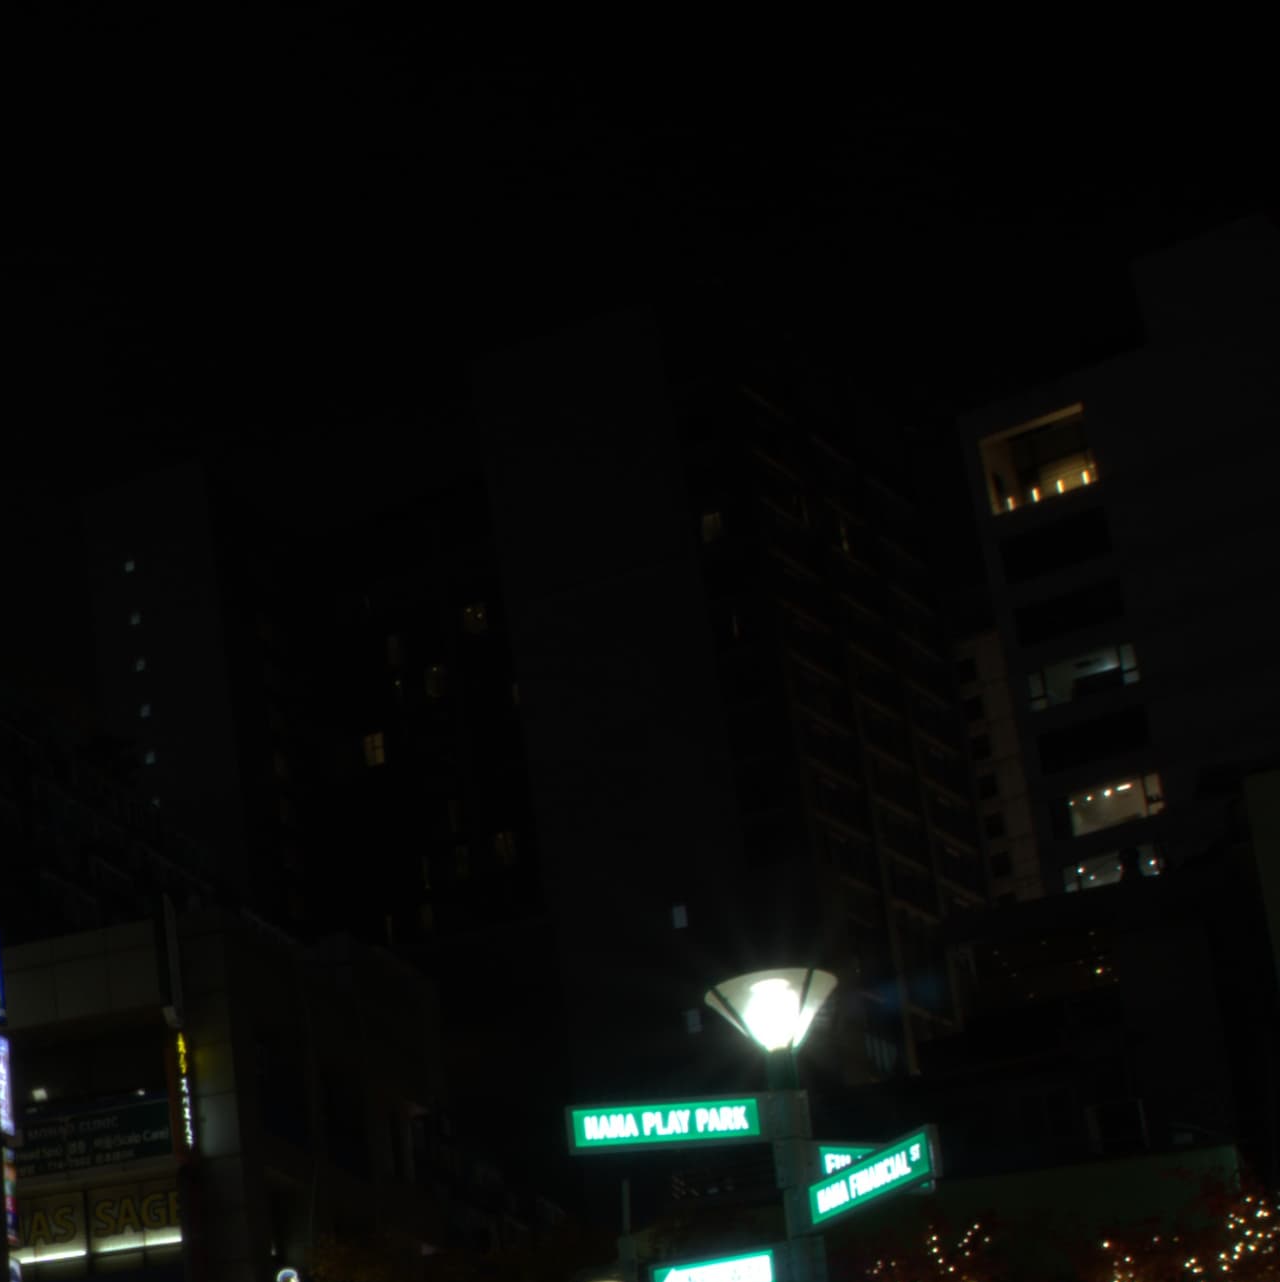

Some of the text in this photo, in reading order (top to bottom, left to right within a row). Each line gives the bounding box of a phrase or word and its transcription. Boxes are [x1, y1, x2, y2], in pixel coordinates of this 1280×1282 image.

[584, 1106, 749, 1140] HANA PLAY PARK
[816, 1179, 850, 1214] HANA
[849, 1152, 911, 1199] FINANCIAL
